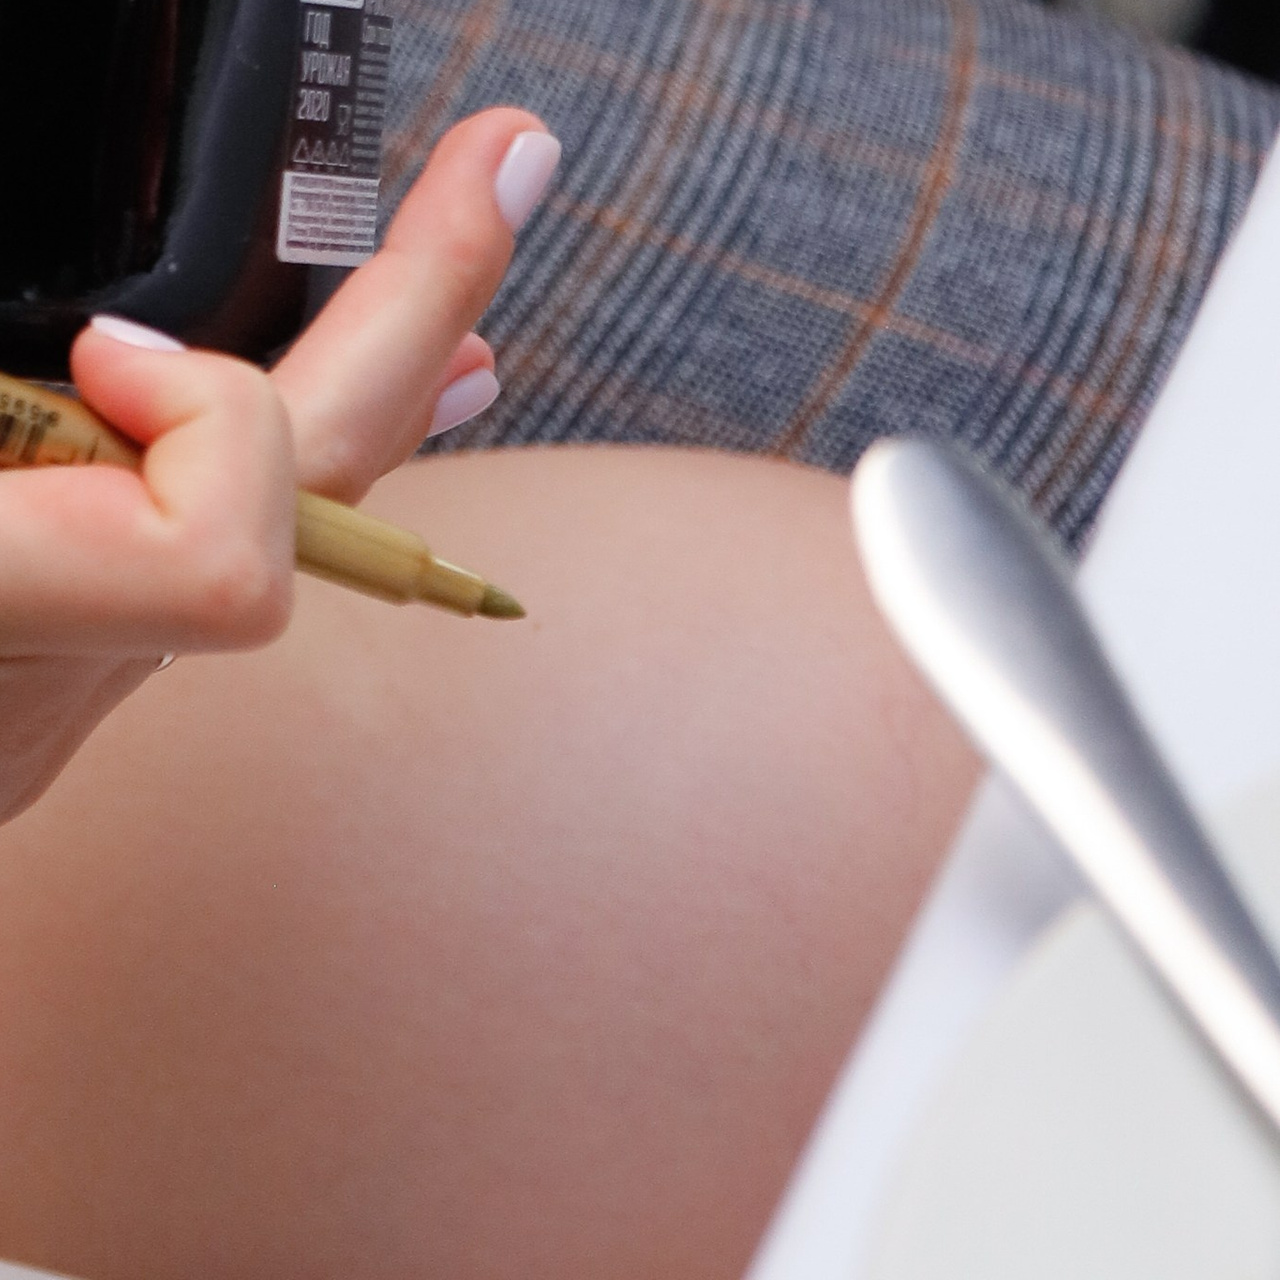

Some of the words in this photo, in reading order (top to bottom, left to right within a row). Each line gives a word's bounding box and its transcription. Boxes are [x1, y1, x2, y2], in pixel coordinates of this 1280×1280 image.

[305, 11, 331, 50] ГОД
[300, 51, 352, 87] УРОЖАЯ
[297, 88, 330, 122] 2020
